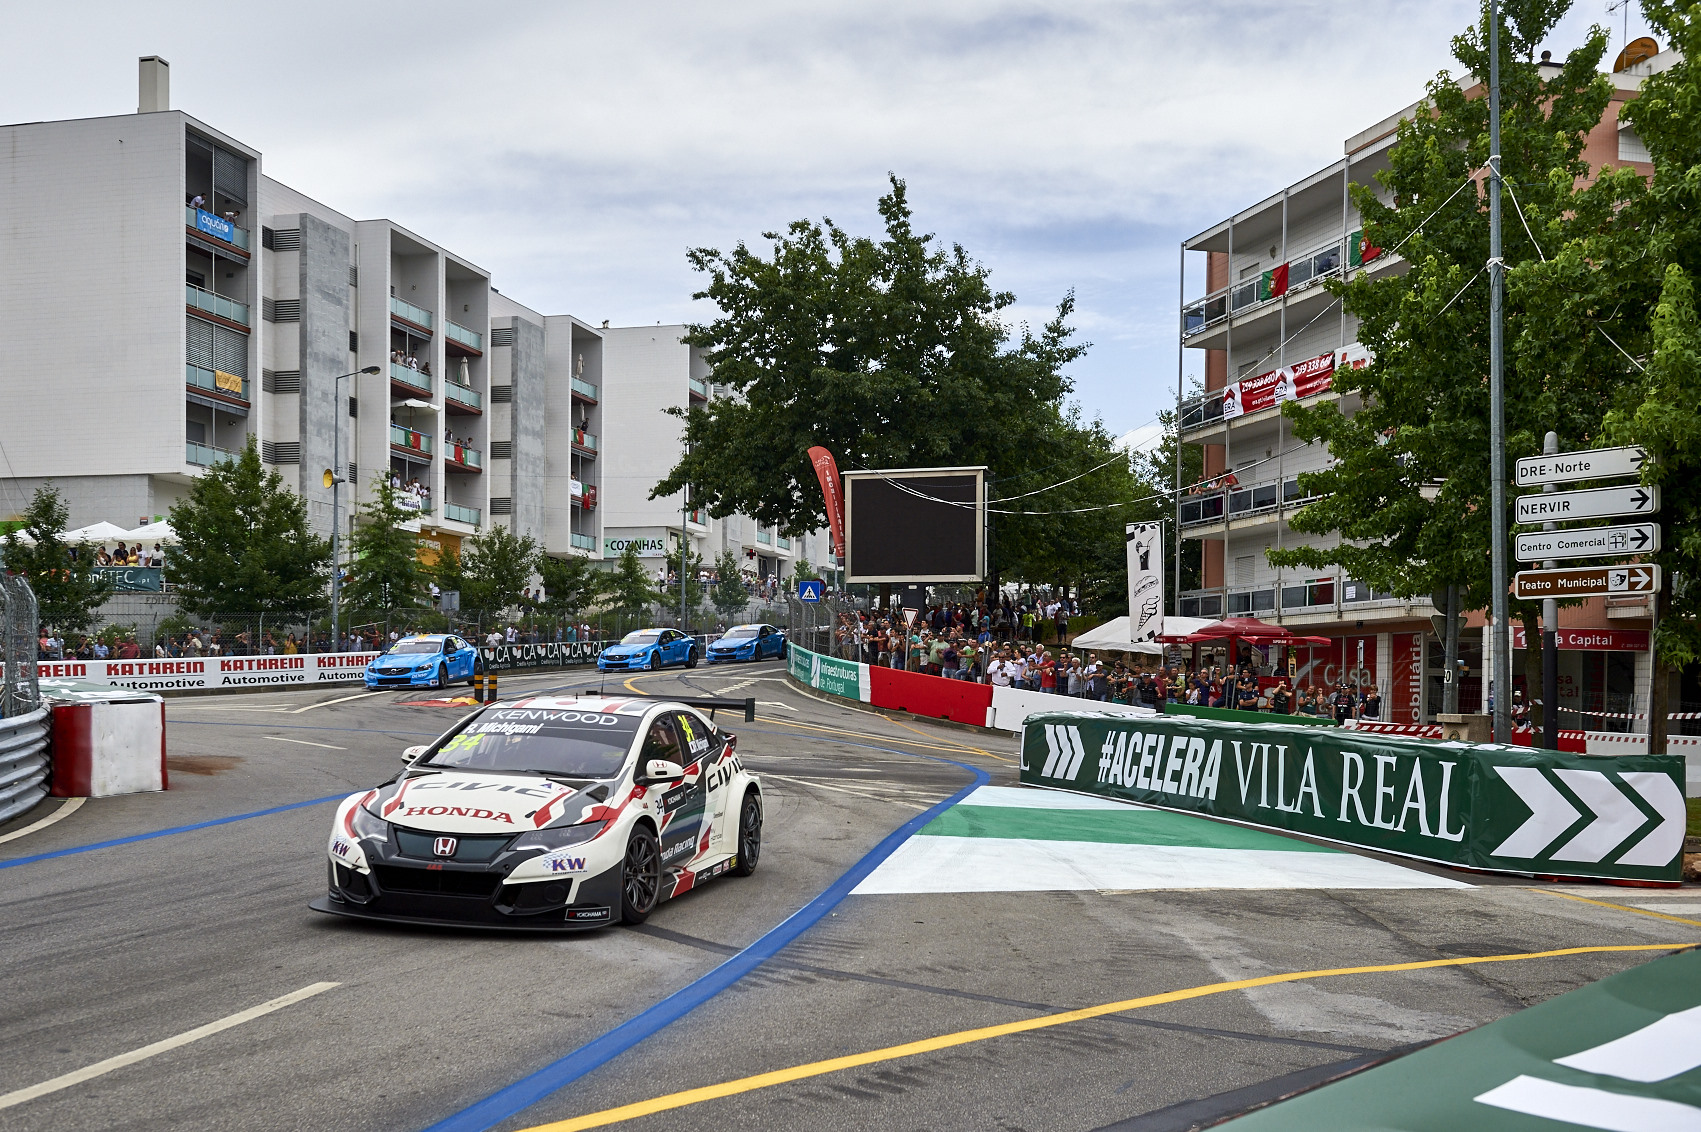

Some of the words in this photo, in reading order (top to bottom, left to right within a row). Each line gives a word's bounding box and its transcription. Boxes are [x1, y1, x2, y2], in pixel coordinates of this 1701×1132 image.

[1275, 385, 1288, 396] ERA
[1224, 401, 1236, 412] ERA
[1520, 500, 1571, 515] NERVIR
[610, 539, 663, 551] COZNHAS
[1520, 542, 1552, 552] Centro
[1557, 537, 1606, 550] Comercial
[1520, 580, 1552, 590] Teatro
[1557, 576, 1607, 589] Municipal
[1569, 634, 1613, 647] Capital
[496, 645, 511, 663] CA
[523, 644, 537, 660] CA
[547, 643, 560, 659] CA
[571, 642, 583, 658] CA
[106, 661, 205, 676] KATHREIN
[220, 657, 304, 672] KATHREIN
[317, 655, 379, 668] KATHRE
[37, 663, 87, 678] REIN
[318, 671, 364, 681] Automo
[1324, 664, 1371, 686] Casa
[109, 678, 205, 690] Automotive
[221, 673, 305, 685] Automotive
[1409, 634, 1421, 723] obiliária
[826, 678, 845, 695] Portugal
[490, 710, 619, 726] KENWOOD
[462, 723, 476, 734] R.
[476, 721, 545, 736] Michigami
[437, 733, 487, 753] 34
[412, 781, 552, 799] CIVIC
[1097, 730, 1223, 800] #ACELERA
[1230, 740, 1326, 818] VILA
[1336, 751, 1466, 842] REAL
[403, 806, 515, 825] HONDA
[332, 841, 351, 857] KW
[674, 835, 696, 855] Racing
[552, 857, 587, 871] KW
